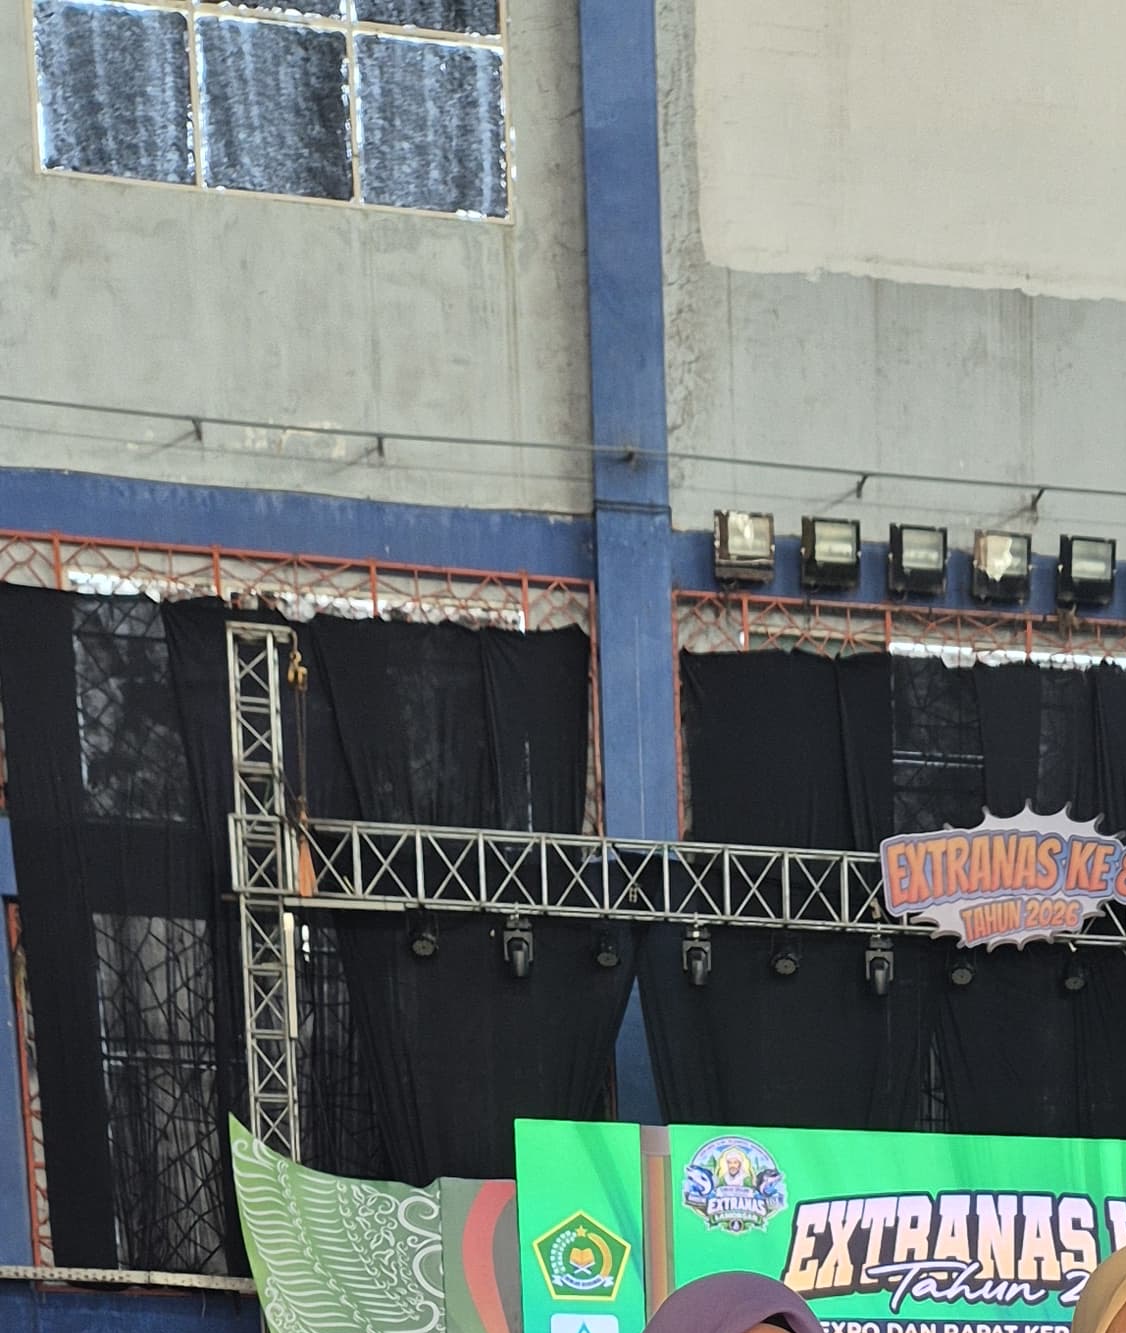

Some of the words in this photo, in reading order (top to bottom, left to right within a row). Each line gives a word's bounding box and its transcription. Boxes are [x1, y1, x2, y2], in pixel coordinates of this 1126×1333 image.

[886, 835, 1062, 906] EXTRANAS
[1066, 841, 1115, 891] KE
[962, 900, 1020, 942] TAHUN
[1024, 900, 1079, 930] 2026
[707, 1197, 767, 1216] EXTRANAS
[784, 1194, 1098, 1292] EXTRANAS
[866, 1261, 1046, 1312] Tahun
